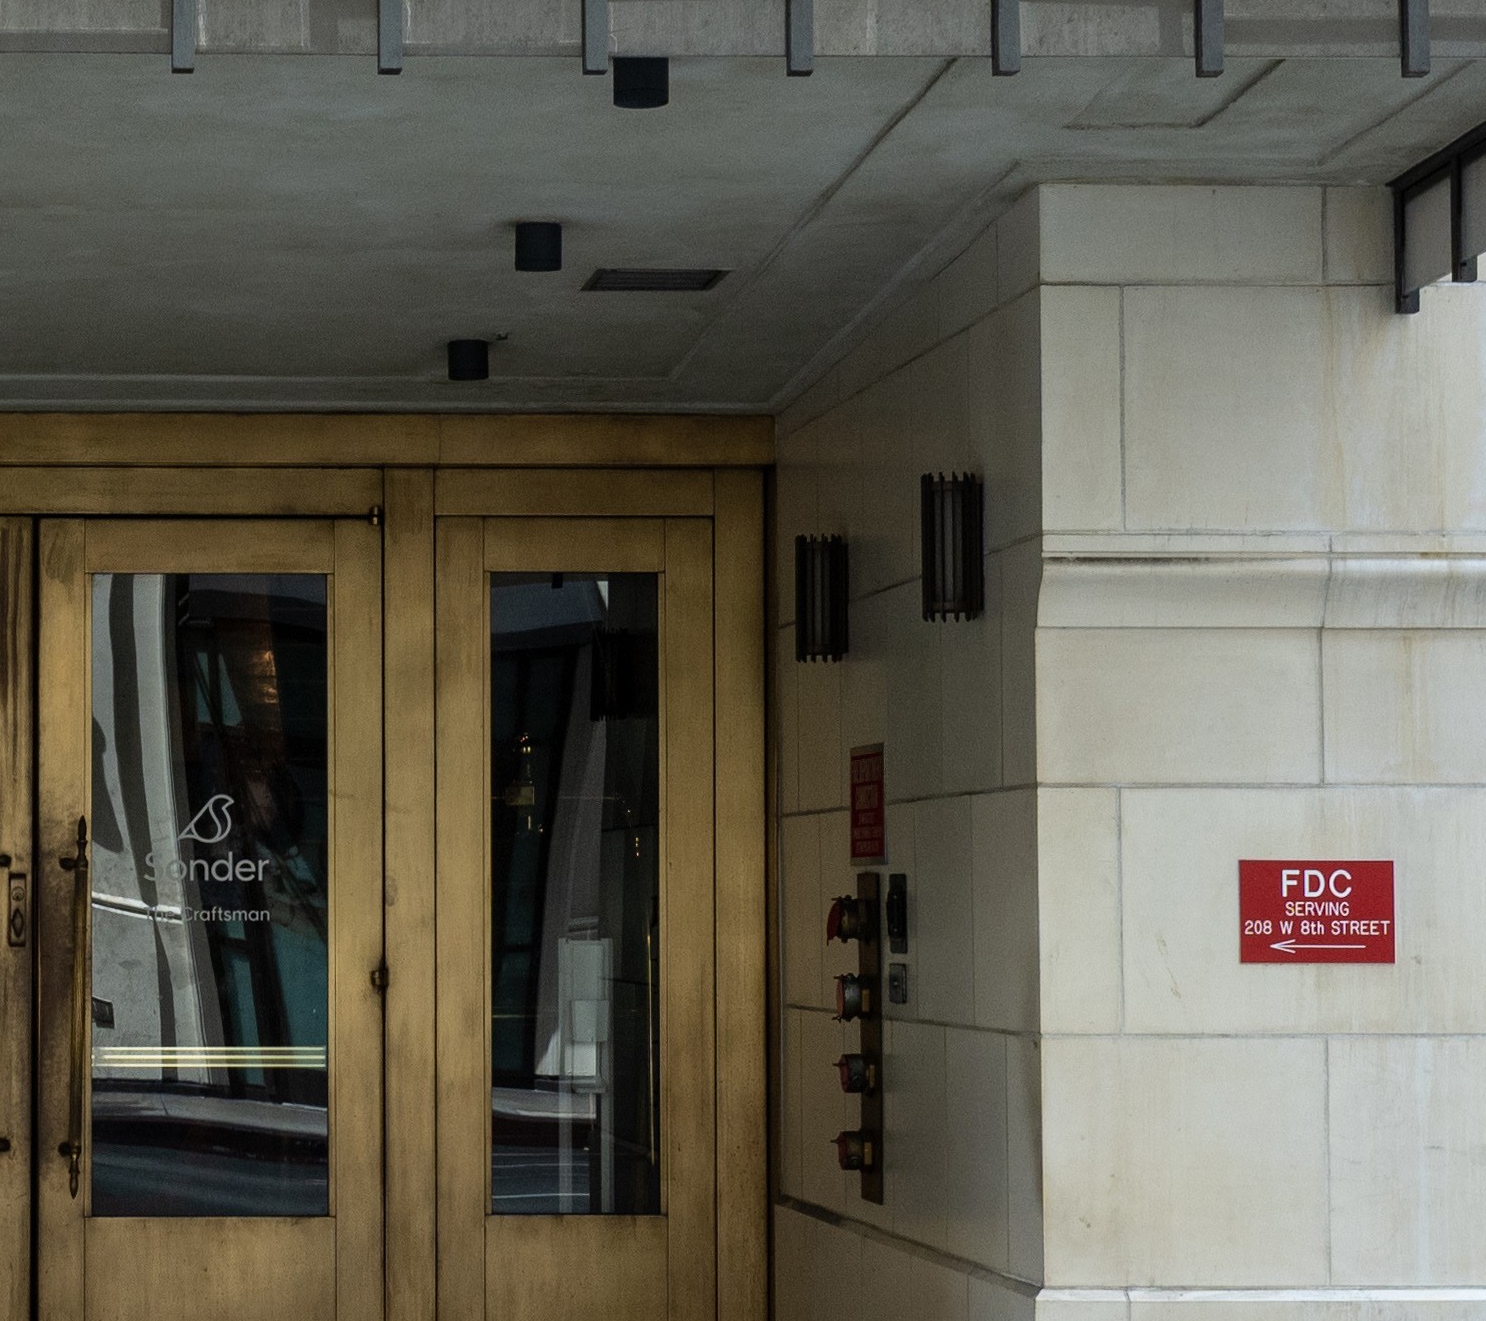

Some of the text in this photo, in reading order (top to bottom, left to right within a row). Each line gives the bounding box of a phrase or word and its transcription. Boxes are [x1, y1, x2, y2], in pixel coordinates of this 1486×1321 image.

[144, 851, 270, 882] Sonder
[1281, 869, 1352, 898] FDC
[185, 906, 271, 922] Craftsman
[1285, 901, 1350, 916] SERVING
[1244, 920, 1391, 935] 208 W 8th STREET
